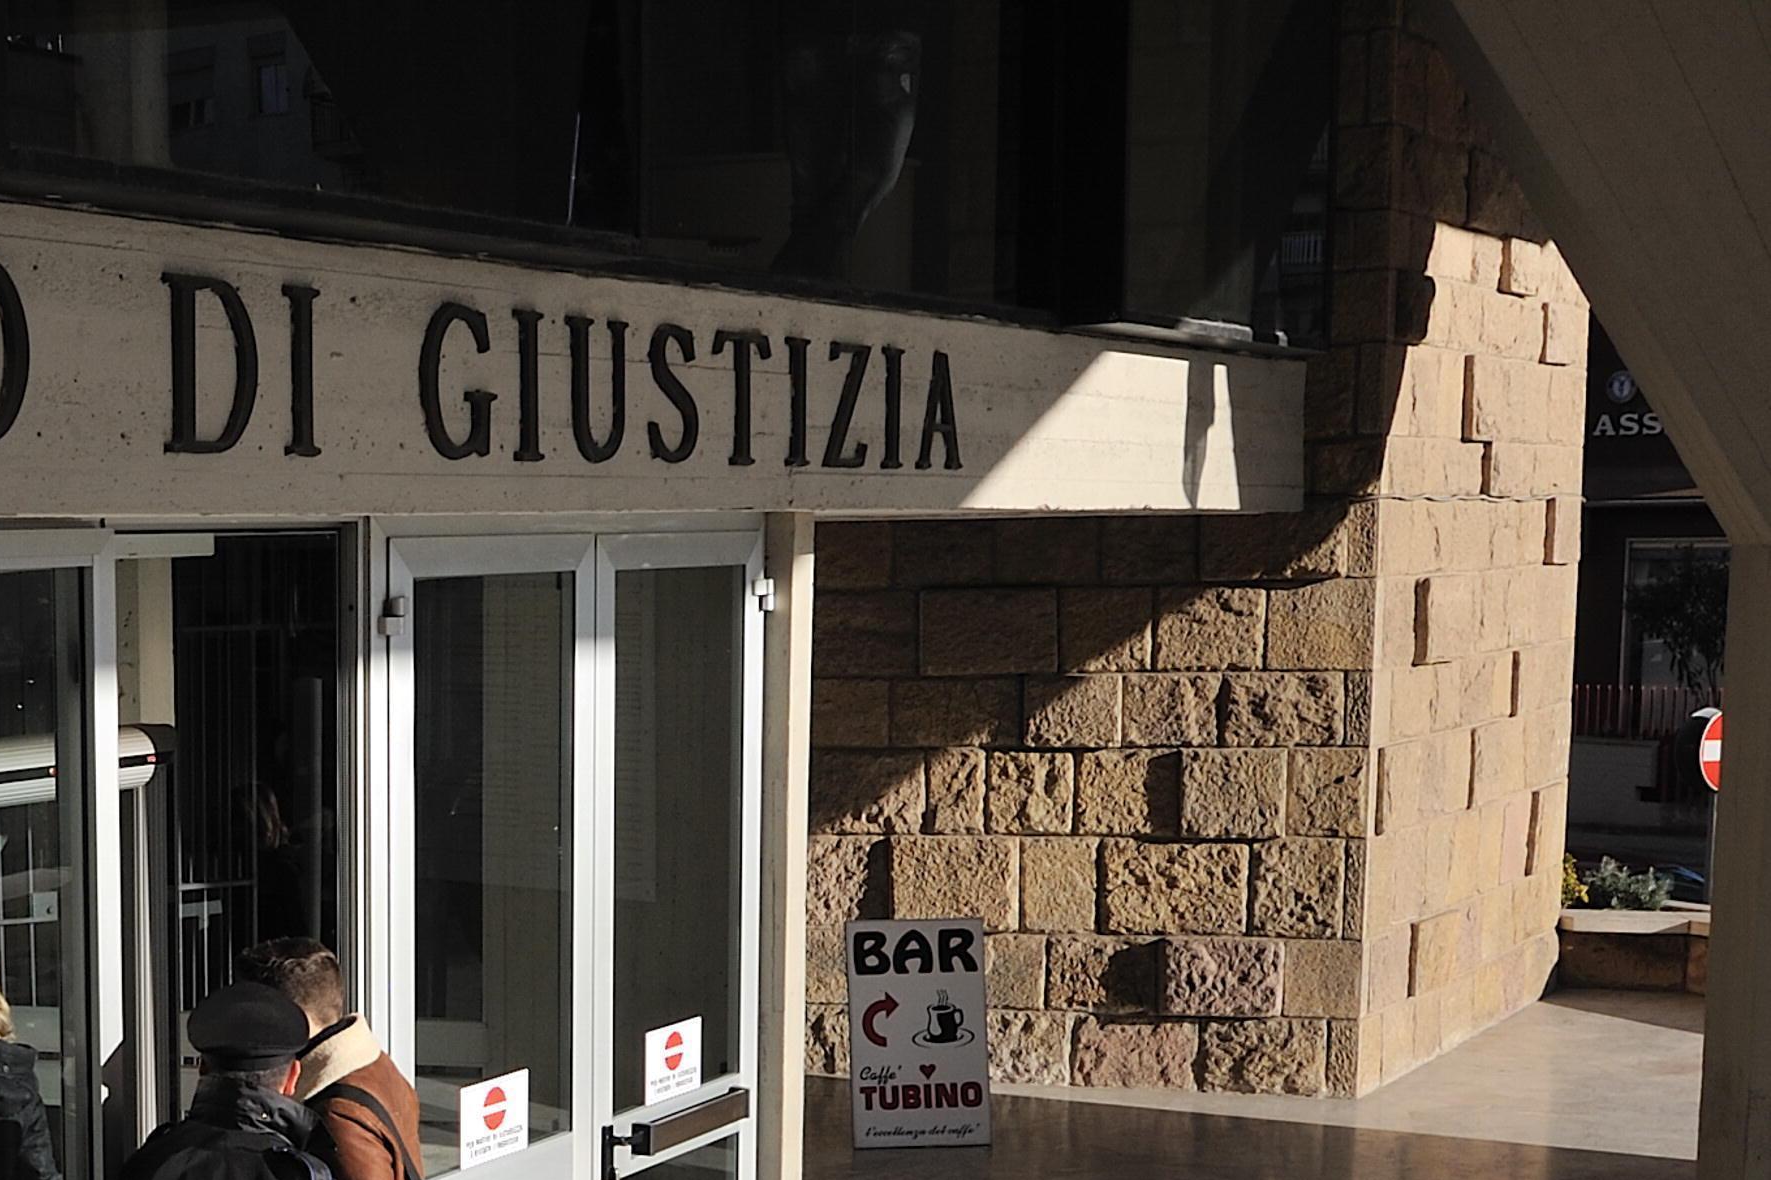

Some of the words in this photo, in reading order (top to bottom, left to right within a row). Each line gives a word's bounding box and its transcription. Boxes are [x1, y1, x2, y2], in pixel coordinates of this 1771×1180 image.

[161, 271, 321, 458] DI
[418, 300, 964, 471] GIUSTIZIA
[853, 928, 979, 976] BAR
[859, 1081, 983, 1111] TUBINO
